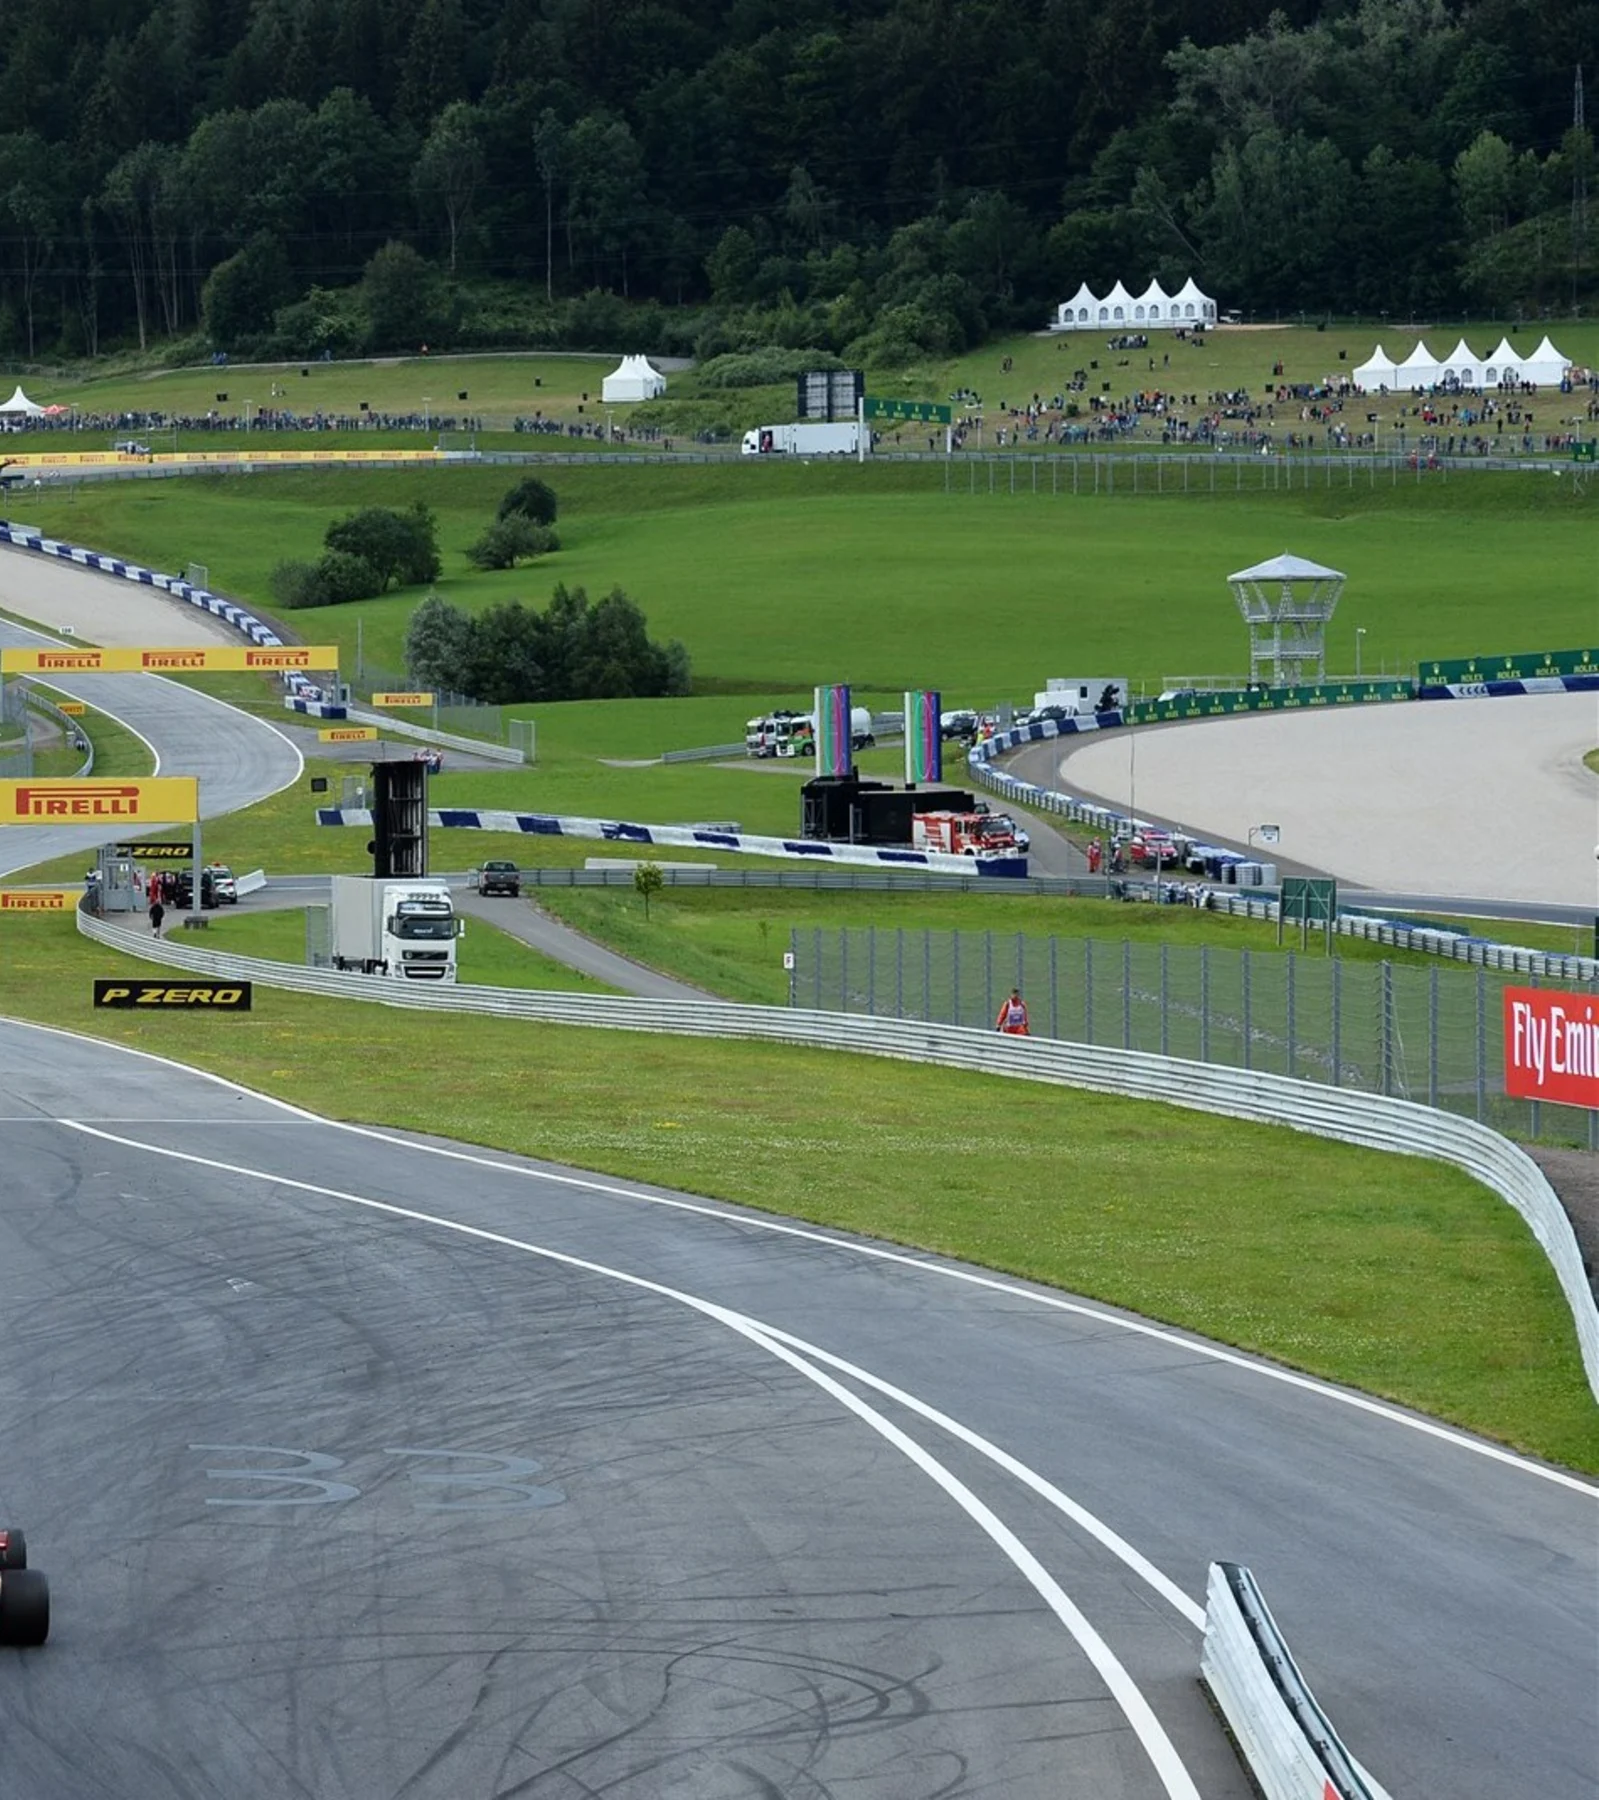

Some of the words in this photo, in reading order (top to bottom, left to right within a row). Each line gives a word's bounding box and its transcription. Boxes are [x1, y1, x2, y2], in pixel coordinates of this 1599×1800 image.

[38, 653, 101, 668] PIRELLI
[143, 652, 205, 667] PIRELLI
[247, 651, 309, 666] PIRELLI
[16, 786, 140, 815] PIRELLI
[133, 847, 189, 856] ZERO
[1, 893, 64, 908] PIRELLI
[102, 989, 130, 1003] P
[136, 989, 243, 1004] ZERO
[1512, 1001, 1547, 1086] Fly
